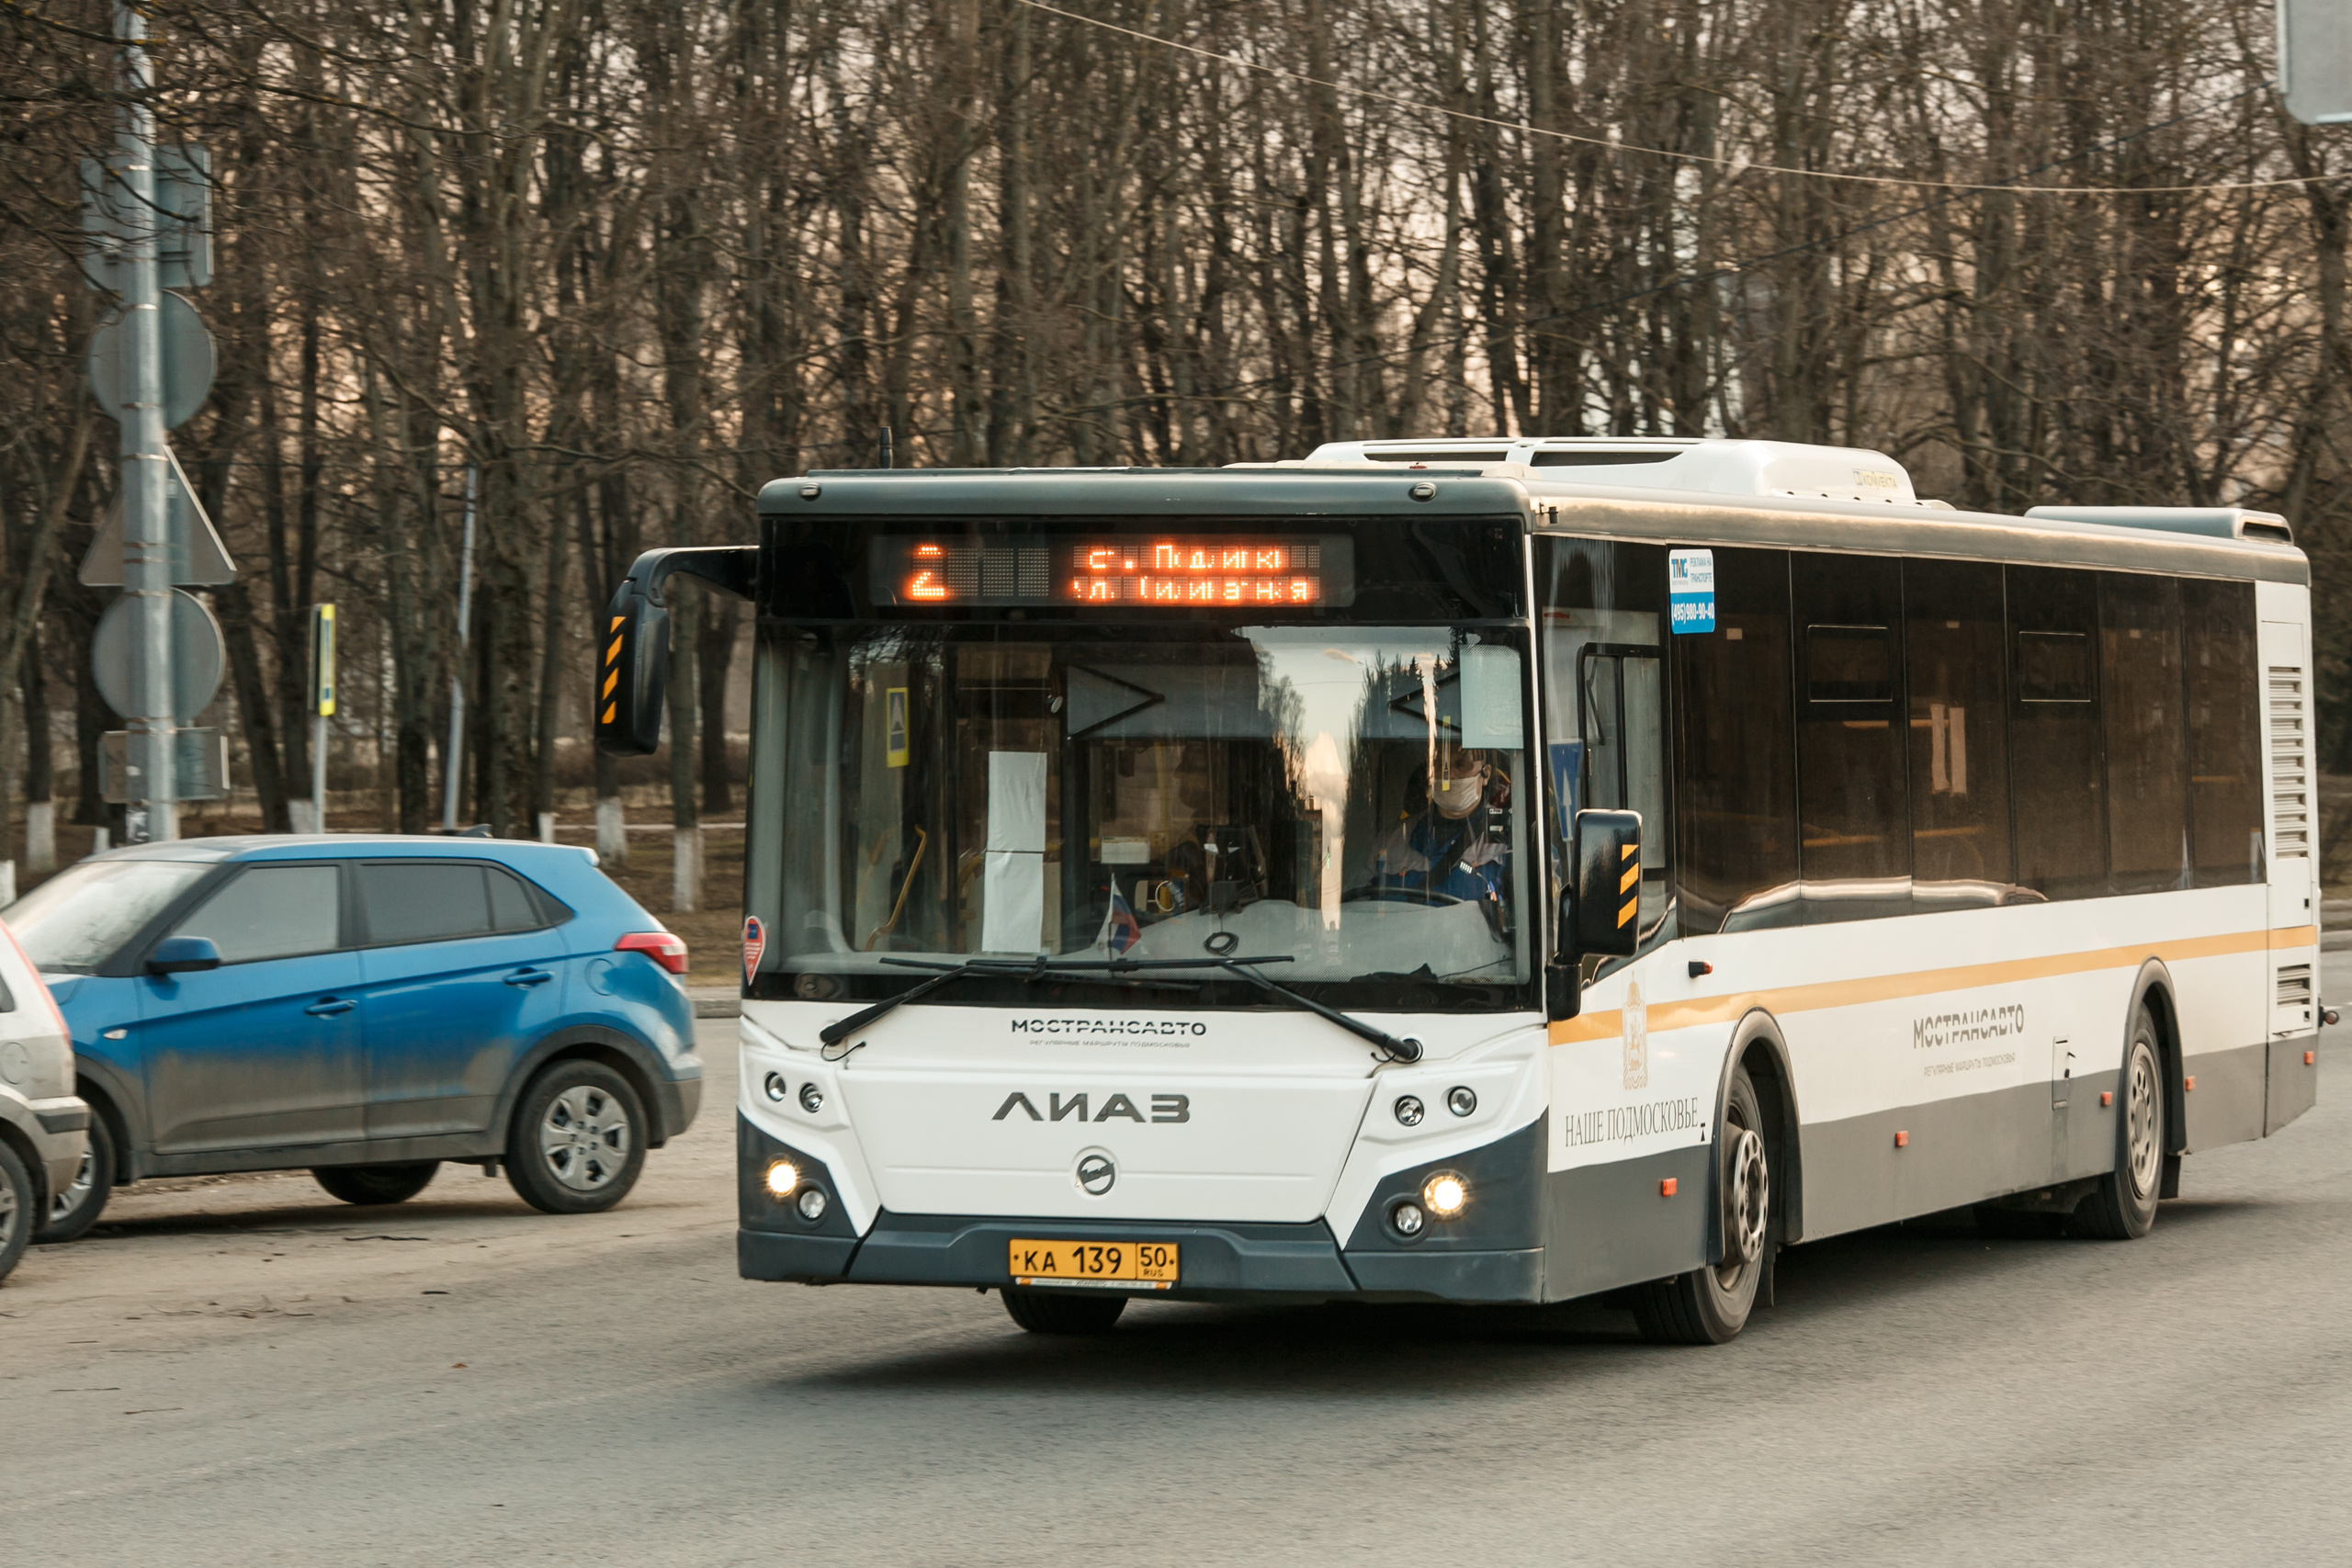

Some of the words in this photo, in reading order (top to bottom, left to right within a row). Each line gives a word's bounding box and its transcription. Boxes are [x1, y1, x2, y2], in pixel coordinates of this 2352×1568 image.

[1012, 1019, 1207, 1036] МОСТРАНСАВТО
[1913, 1003, 2024, 1049] МОСТРАНСАВТО
[991, 1091, 1191, 1123] ЛИАЗ
[1565, 1111, 1604, 1147] НАШЕ
[1607, 1097, 1699, 1146] ПОДМОСКОВЬЕ
[1072, 1246, 1122, 1274] 139
[1140, 1247, 1167, 1268] 50
[1143, 1269, 1164, 1277] RUS
